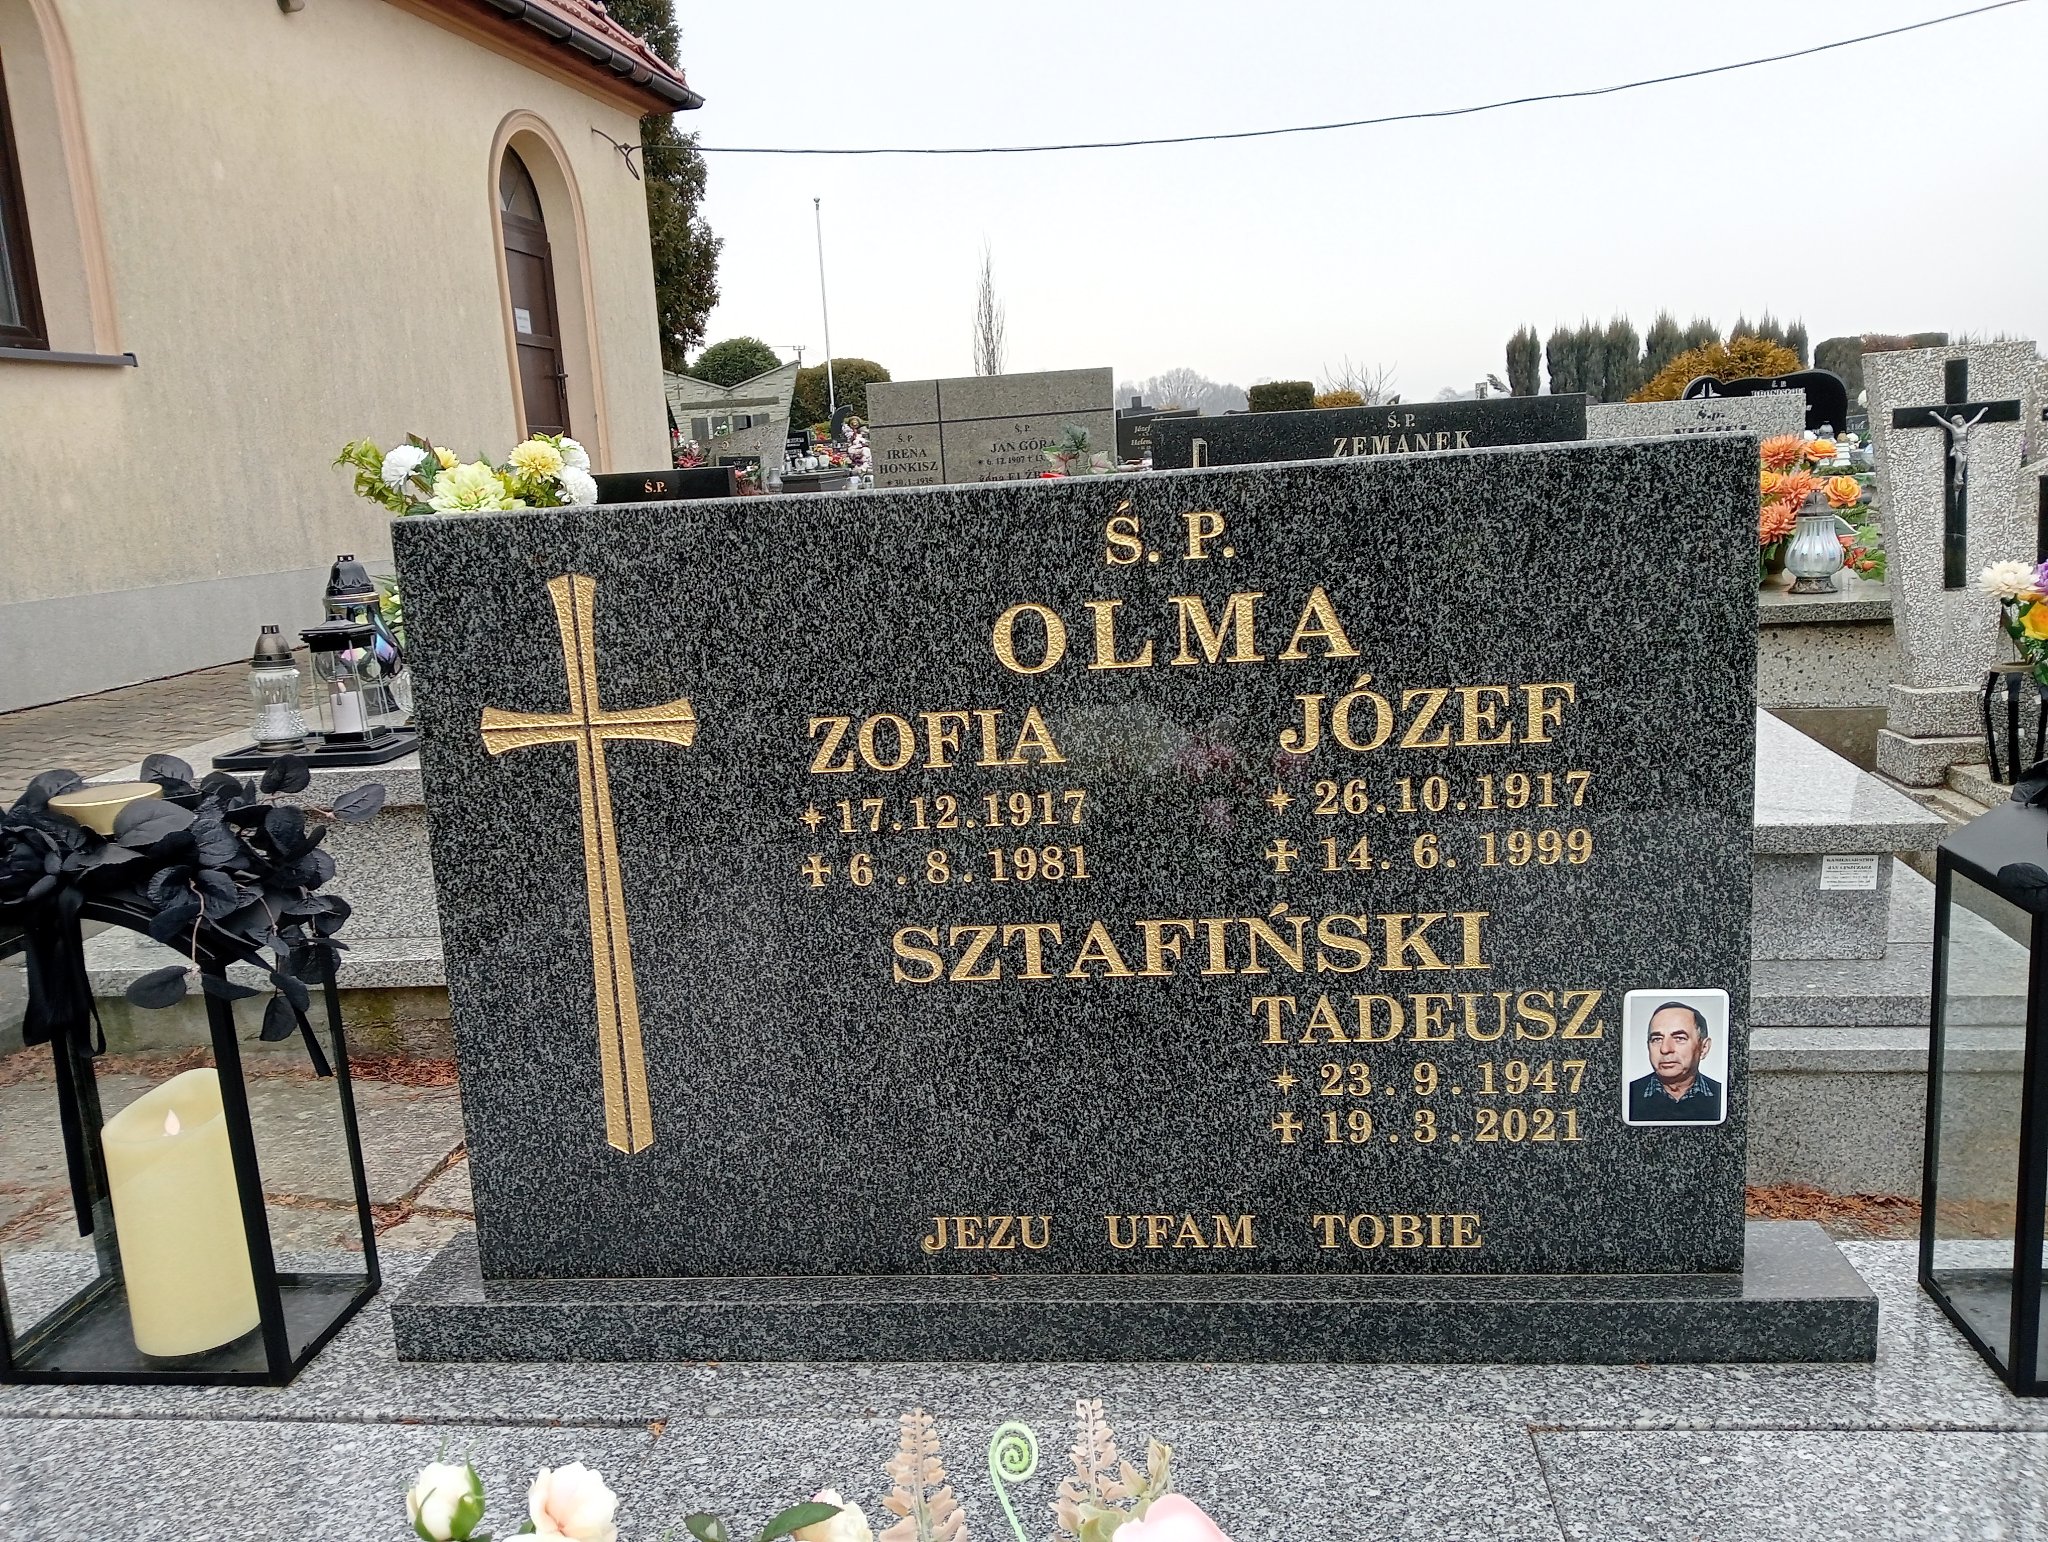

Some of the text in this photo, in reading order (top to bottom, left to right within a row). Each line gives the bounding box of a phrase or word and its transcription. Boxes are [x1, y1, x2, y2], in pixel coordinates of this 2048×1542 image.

[1387, 411, 1416, 428] Ś. P.
[887, 448, 928, 460] IRENA
[990, 437, 1057, 453] JAN GÓRA
[1333, 430, 1473, 458] ZEMANEK
[879, 461, 939, 474] HONKISZ
[1106, 501, 1236, 565] Ś. P.
[993, 587, 1361, 674] OLMA
[1281, 675, 1575, 755] JÓZEF
[810, 708, 1067, 774] ZOFIA
[839, 790, 1086, 833] 17.12.1917
[1316, 772, 1591, 815] 26.10.1917
[894, 904, 1489, 984] SZTAFIŃSKI
[1253, 991, 1604, 1044] TADEUSZ
[924, 1215, 1483, 1253] JEZU UFAM TOBIE
